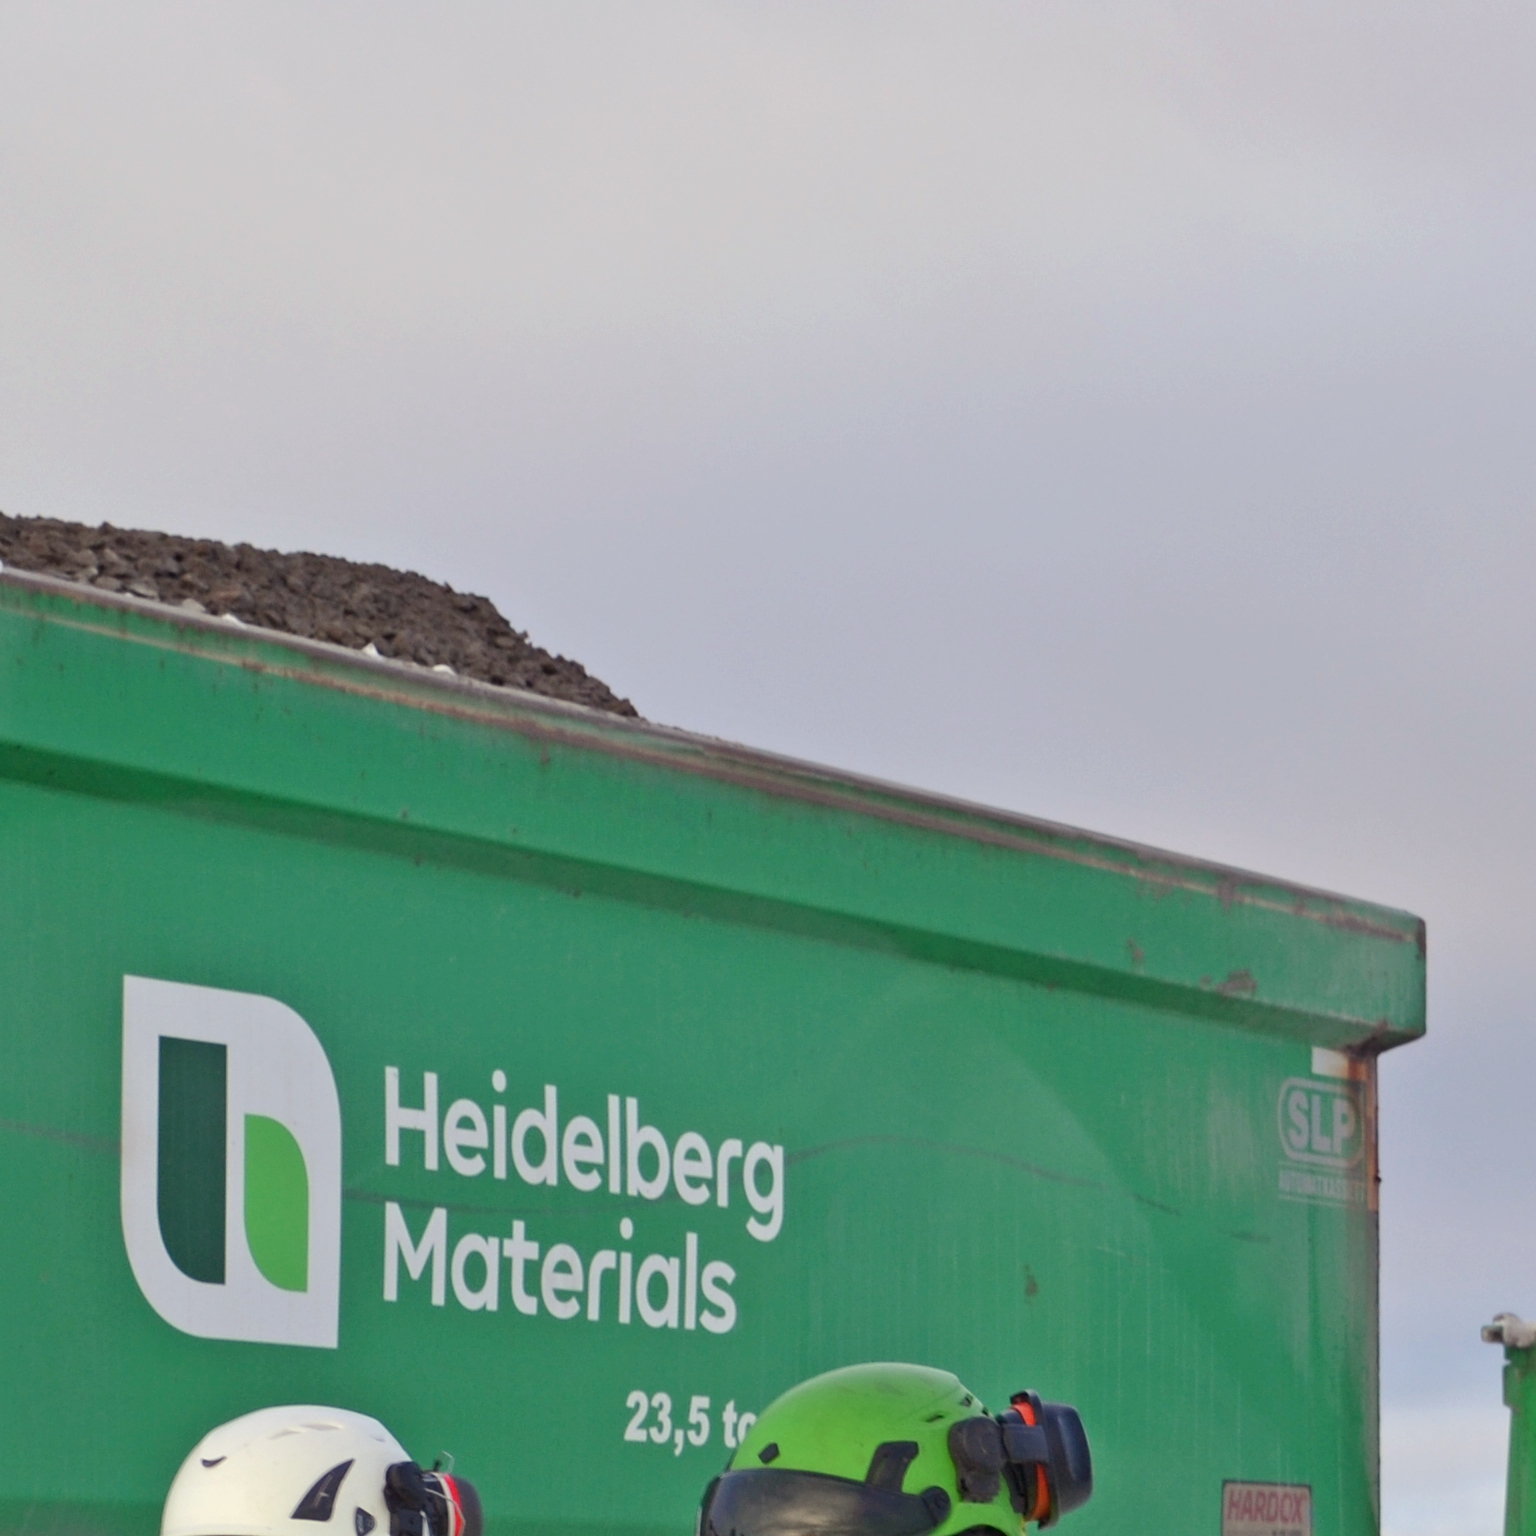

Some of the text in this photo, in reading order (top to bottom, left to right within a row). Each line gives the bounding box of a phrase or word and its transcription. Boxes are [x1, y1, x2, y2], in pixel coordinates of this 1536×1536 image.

[384, 1065, 785, 1243] Heidelberg
[1288, 1090, 1356, 1155] SLP
[383, 1202, 737, 1334] Materials
[624, 1389, 757, 1457] 23,5 to
[1227, 1489, 1307, 1524] HARDOX
